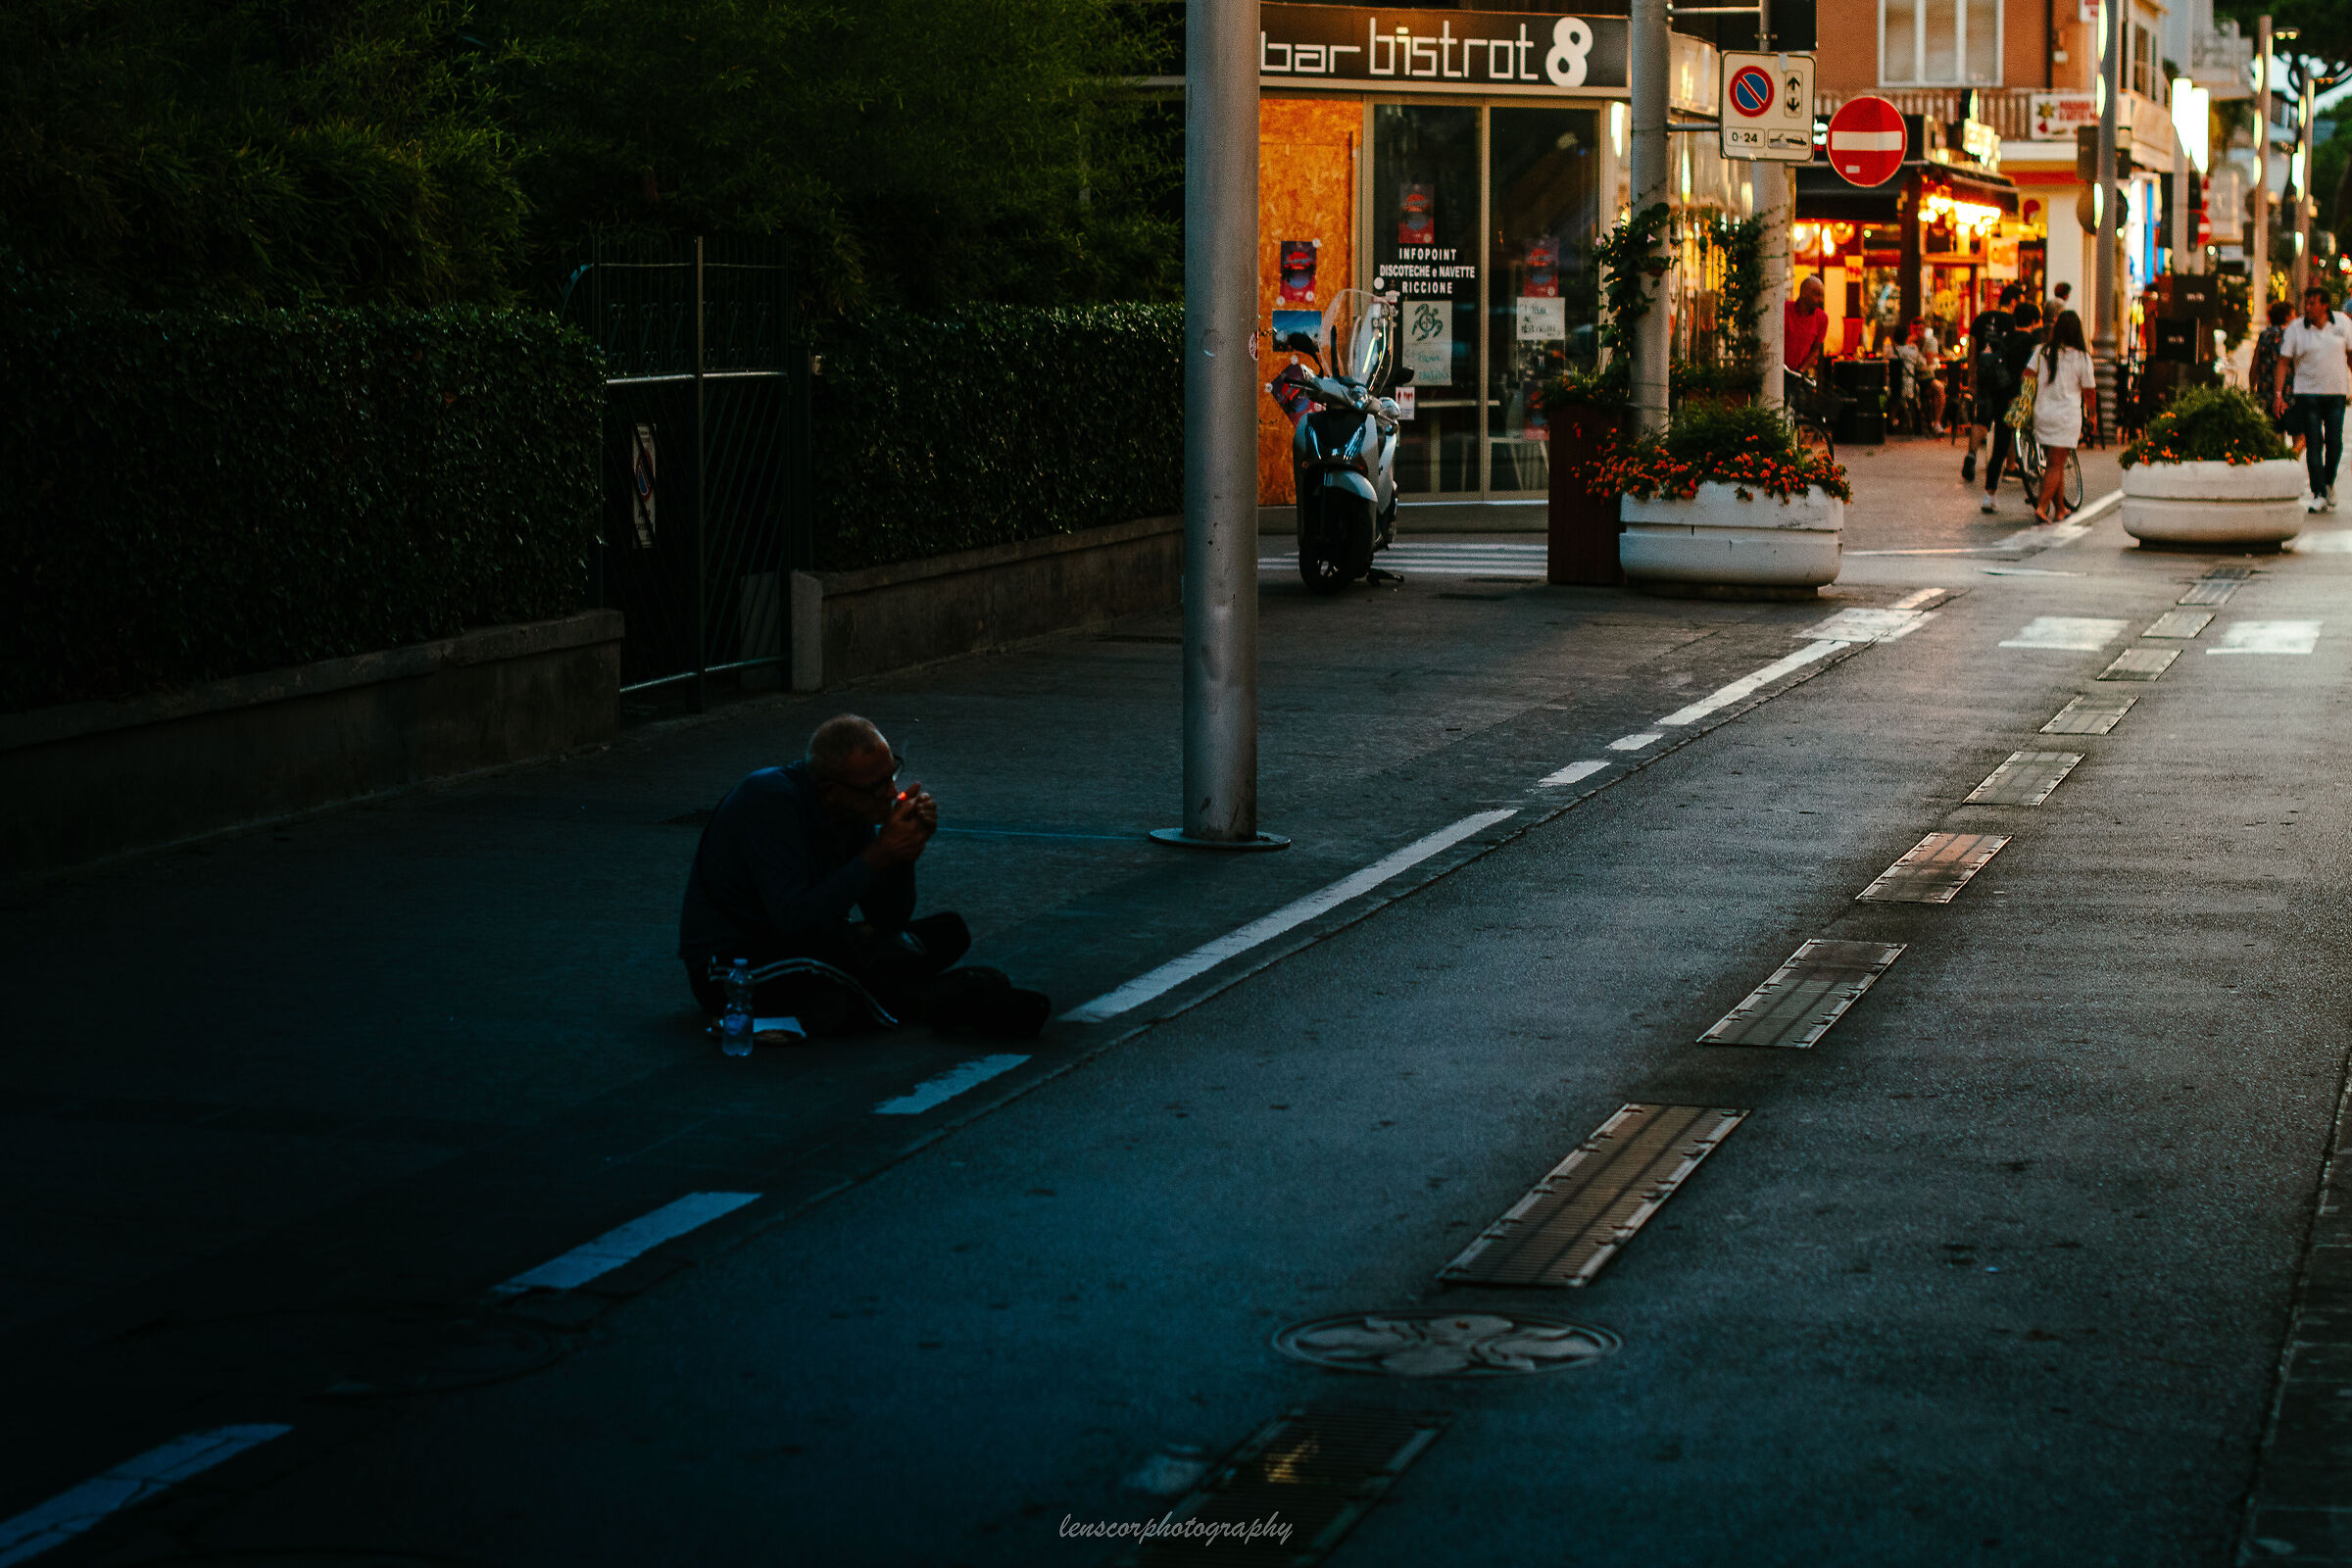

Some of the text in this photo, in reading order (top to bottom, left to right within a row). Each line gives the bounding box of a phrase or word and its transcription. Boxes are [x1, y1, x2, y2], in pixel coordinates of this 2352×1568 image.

[1260, 16, 1593, 88] bar bistrot 8
[1398, 247, 1456, 261] INFOPOINT
[1379, 264, 1475, 278] DISCOTECHE e NAVETTE
[1401, 280, 1452, 294] RICCIONE
